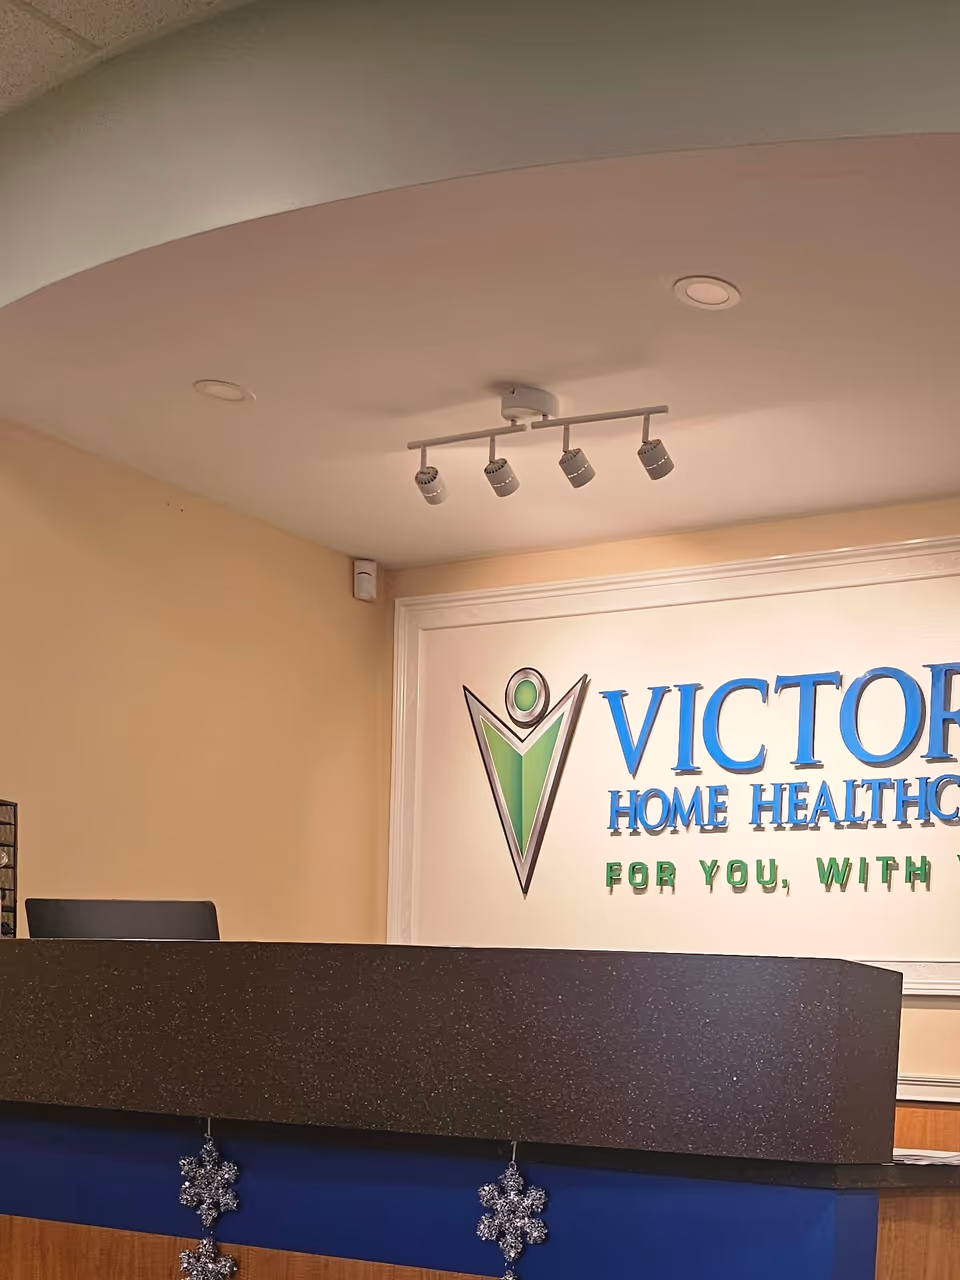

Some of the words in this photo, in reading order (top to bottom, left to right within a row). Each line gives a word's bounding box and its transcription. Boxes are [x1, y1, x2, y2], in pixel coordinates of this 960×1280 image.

[607, 784, 727, 831] HOME
[605, 860, 676, 888] FOR
[699, 858, 788, 890] YOU,
[816, 855, 928, 888] WITH
